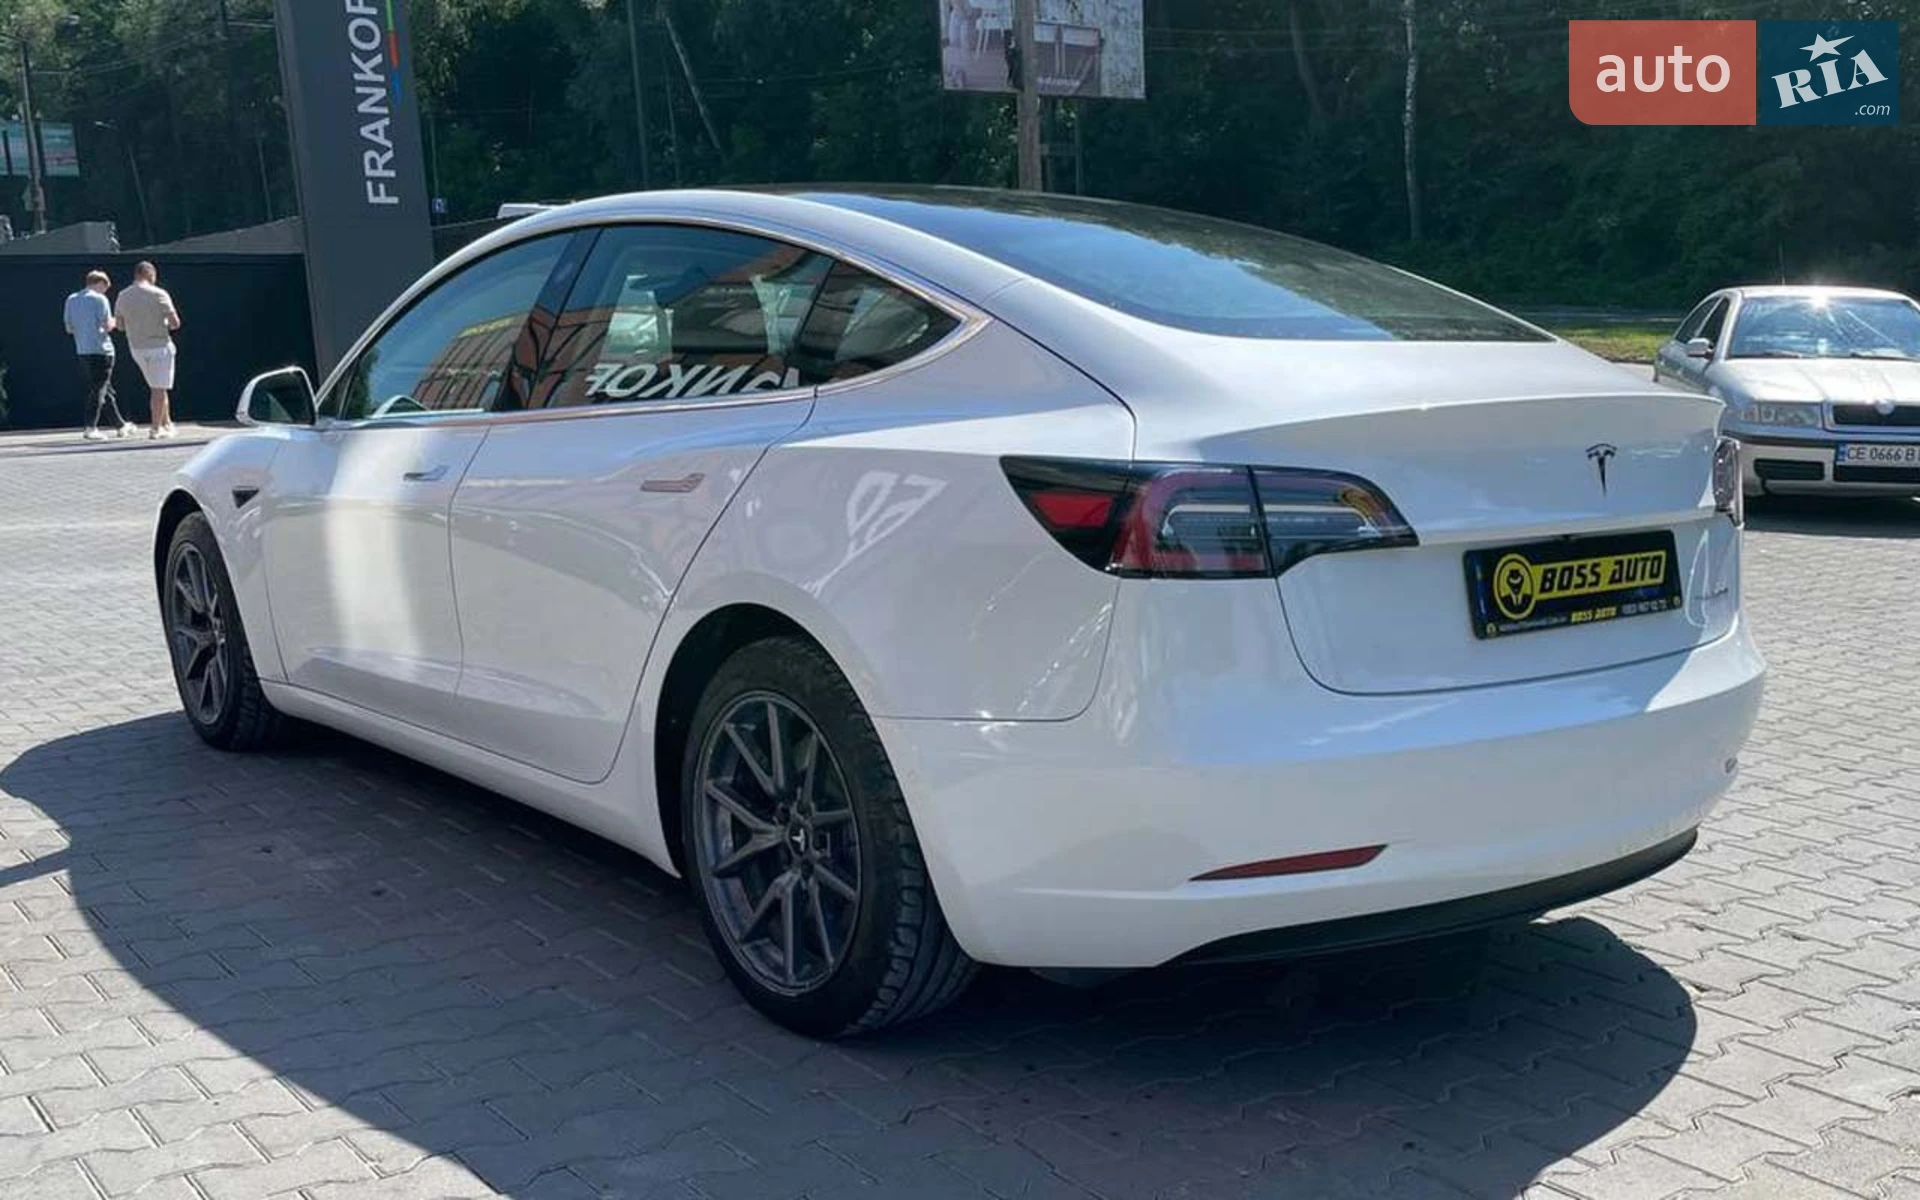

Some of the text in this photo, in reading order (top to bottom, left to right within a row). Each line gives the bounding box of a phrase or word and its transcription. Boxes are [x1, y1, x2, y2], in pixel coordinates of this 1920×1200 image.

[1847, 446, 1867, 460] CE
[1870, 447, 1902, 461] 0666
[1539, 554, 1663, 594] BOSS AUTO
[1571, 610, 1593, 624] BOSS
